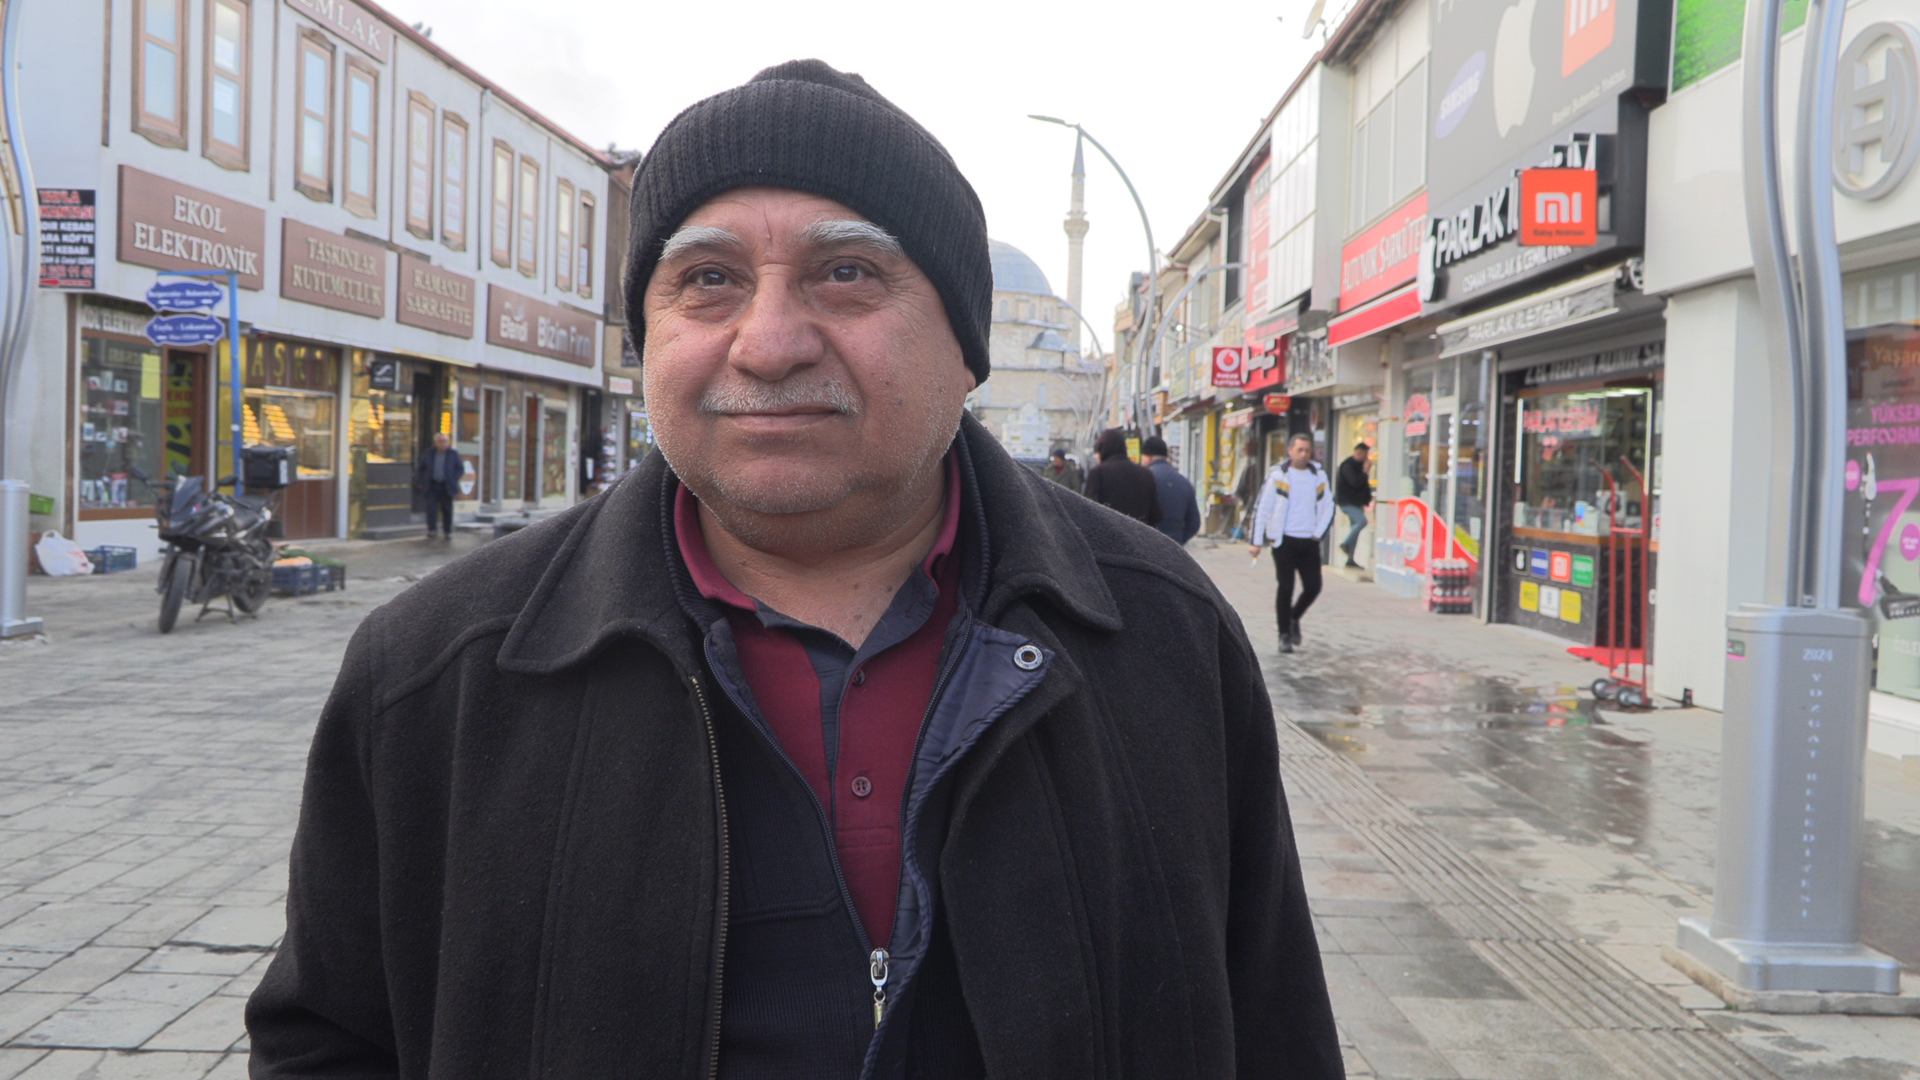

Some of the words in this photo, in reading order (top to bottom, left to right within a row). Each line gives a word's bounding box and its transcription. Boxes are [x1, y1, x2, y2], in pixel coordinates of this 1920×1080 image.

[173, 194, 227, 234] EKOL
[1434, 186, 1508, 269] PARLAK
[133, 221, 258, 276] ELEKTRONİK
[307, 236, 378, 276] TAŞKINLAR
[292, 264, 382, 306] KUYUMCULUK
[1467, 316, 1514, 341] PARLAK
[1802, 647, 1834, 661] 2024
[1808, 672, 1824, 759] YOZGAT
